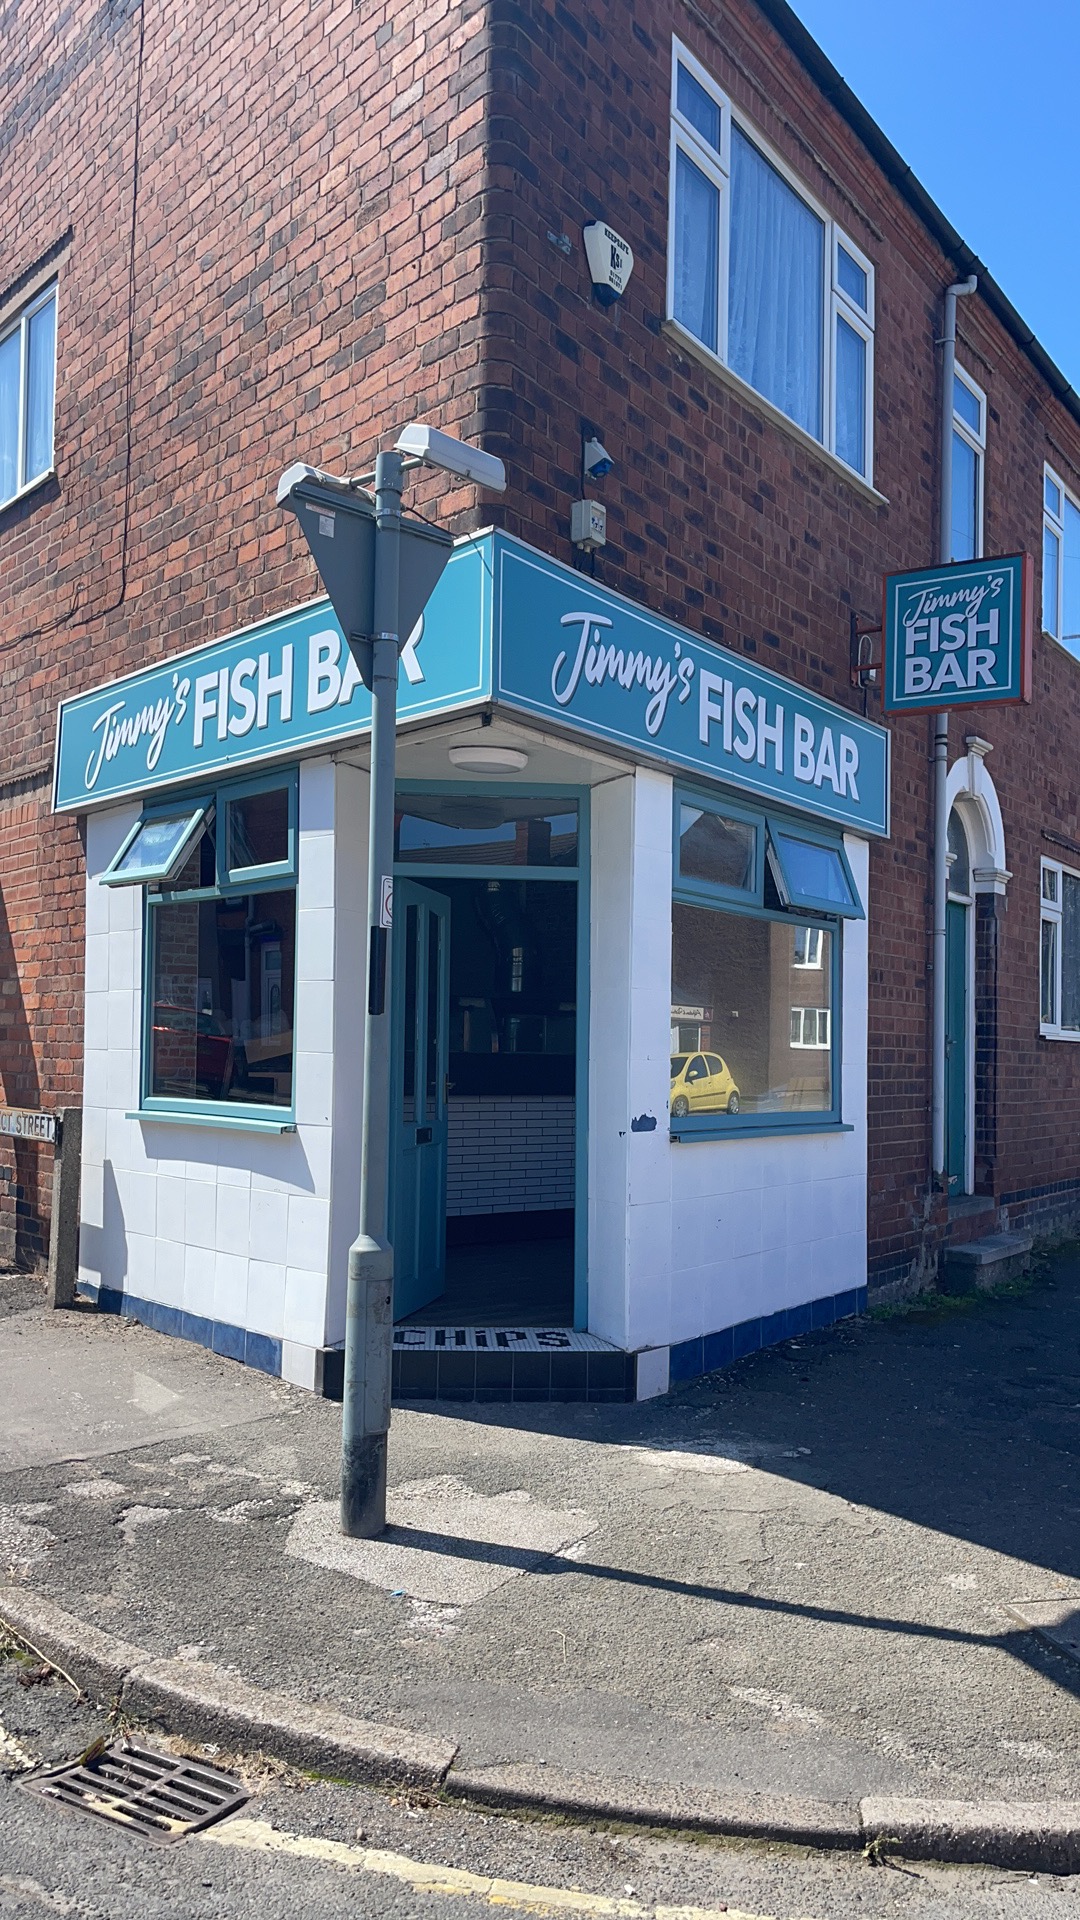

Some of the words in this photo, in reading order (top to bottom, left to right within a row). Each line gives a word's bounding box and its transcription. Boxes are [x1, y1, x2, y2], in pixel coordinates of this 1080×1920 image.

[903, 575, 1004, 627] Jimmy's
[905, 608, 999, 655] FISH
[904, 648, 997, 694] BAR
[84, 673, 191, 790] Jimmy's
[193, 643, 293, 748] FISH
[551, 611, 695, 737] Jimmy's
[699, 668, 785, 773] FISH
[794, 712, 860, 802] BAR
[16, 1114, 52, 1138] STREET
